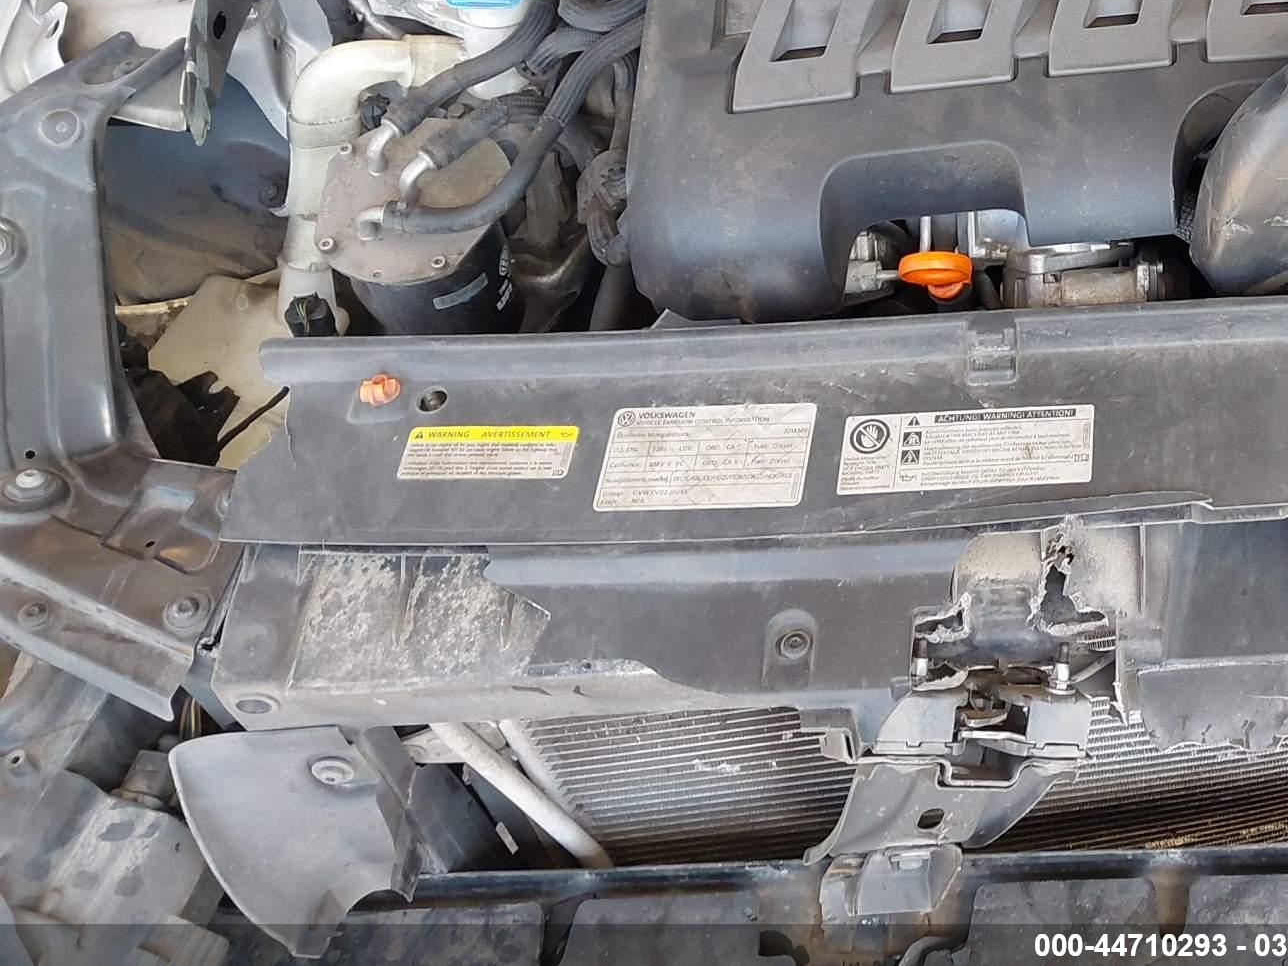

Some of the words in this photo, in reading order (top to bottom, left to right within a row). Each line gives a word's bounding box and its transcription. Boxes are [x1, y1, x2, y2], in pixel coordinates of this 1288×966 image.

[638, 411, 696, 420] VOLKSWAGEN
[938, 413, 982, 423] ACHTUNG!
[983, 411, 1025, 421] WARNING!
[1024, 409, 1074, 419] ATTENTION!
[428, 430, 470, 439] WARNING
[481, 430, 551, 439] AVERTISSEMENT
